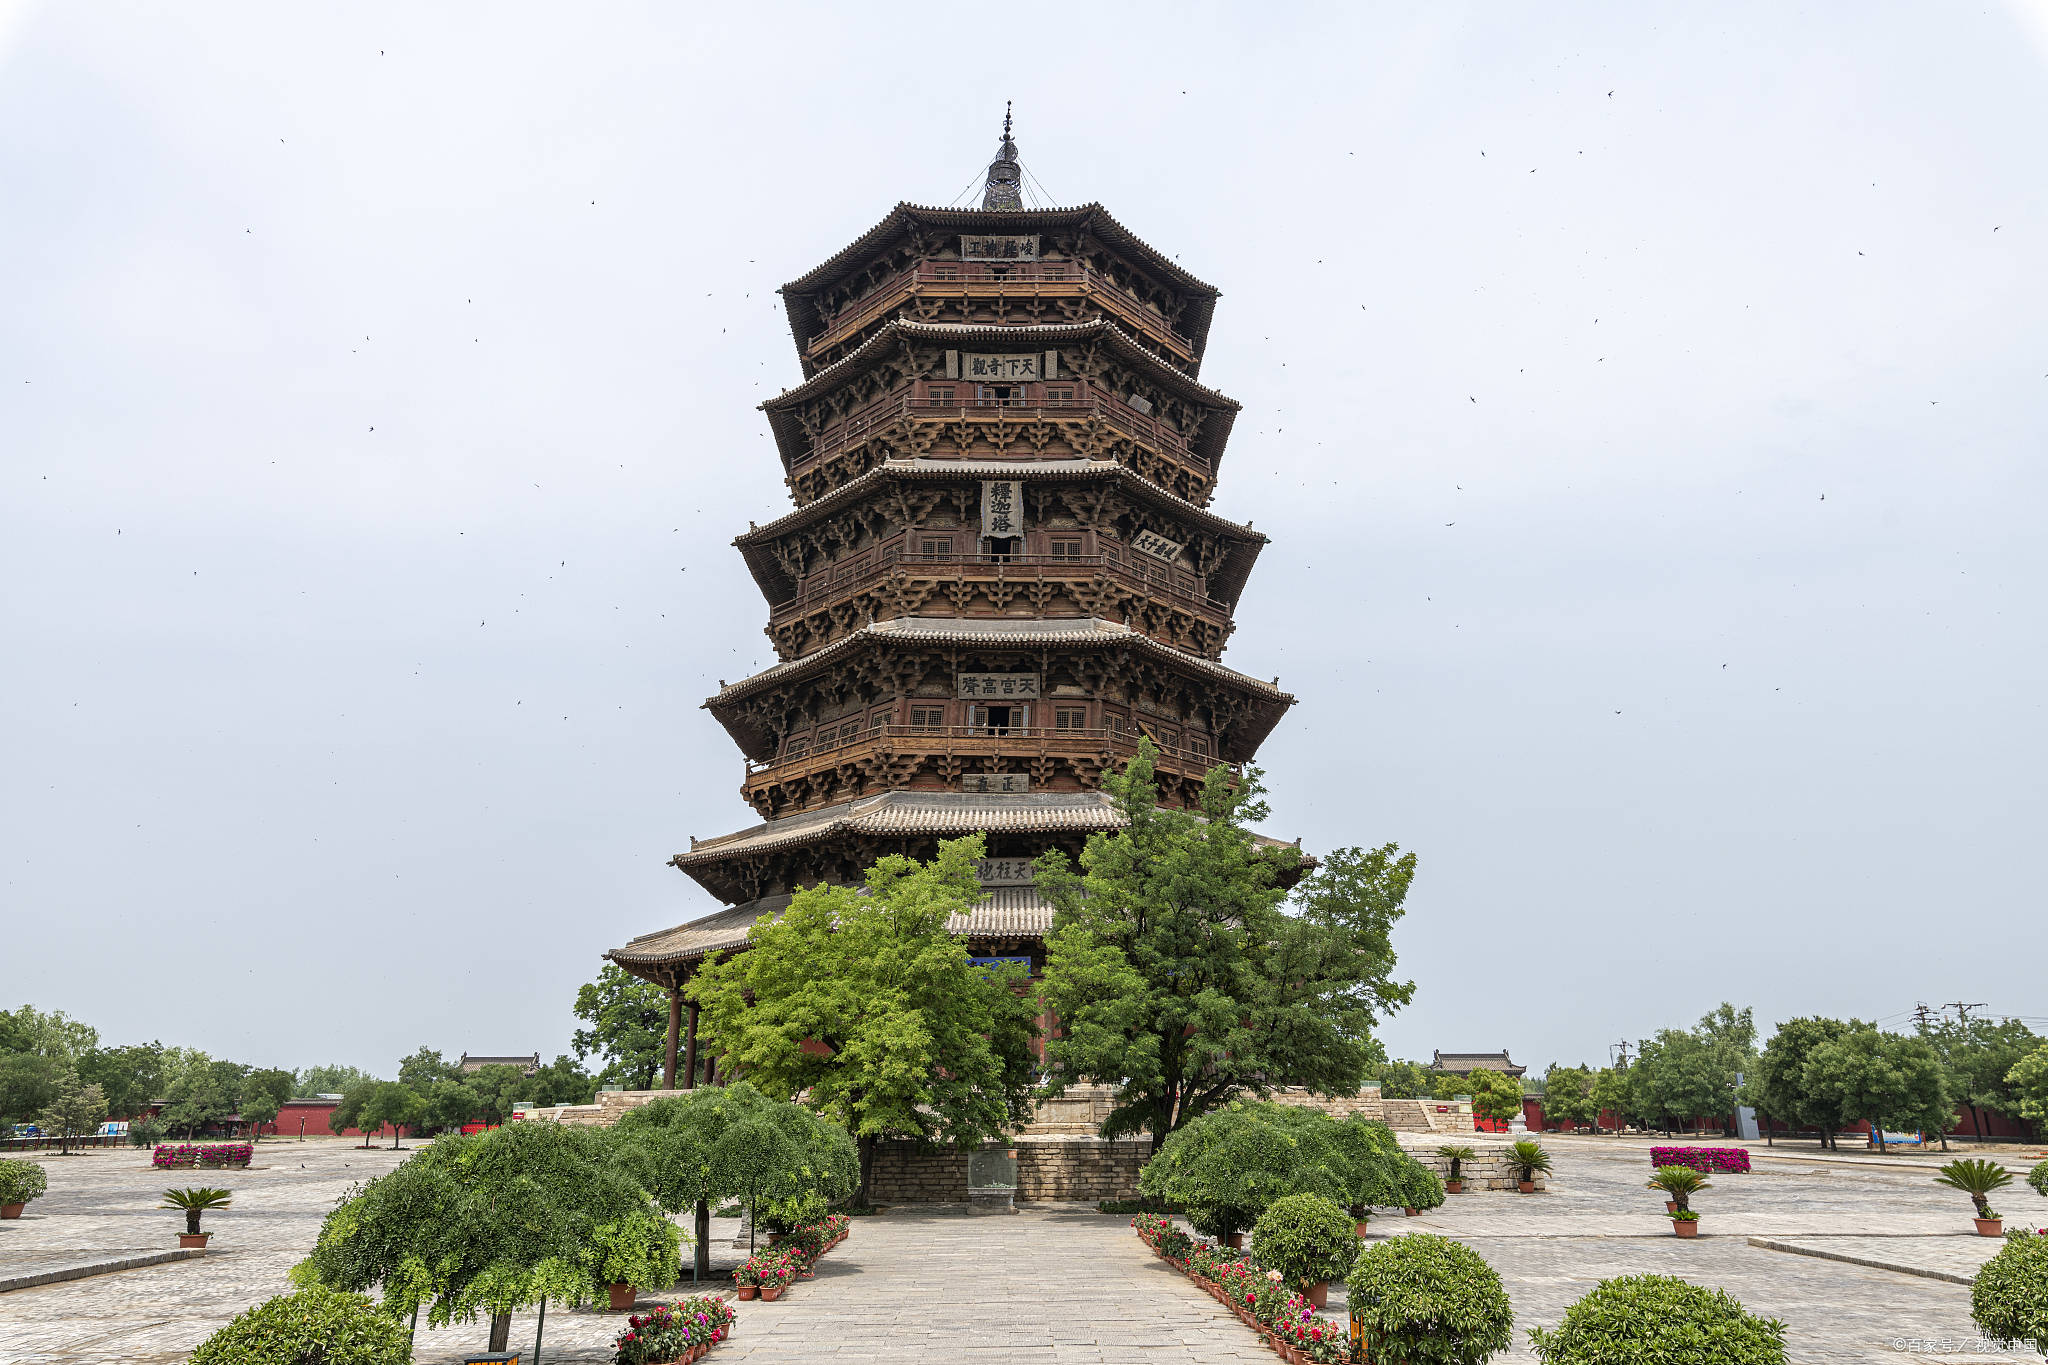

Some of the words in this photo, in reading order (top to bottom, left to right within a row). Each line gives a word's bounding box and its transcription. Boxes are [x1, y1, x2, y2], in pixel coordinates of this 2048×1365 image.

[972, 358, 1035, 376] 天下奇觀
[990, 482, 1015, 532] 釋迦塔
[971, 861, 1029, 881] 天柱地
